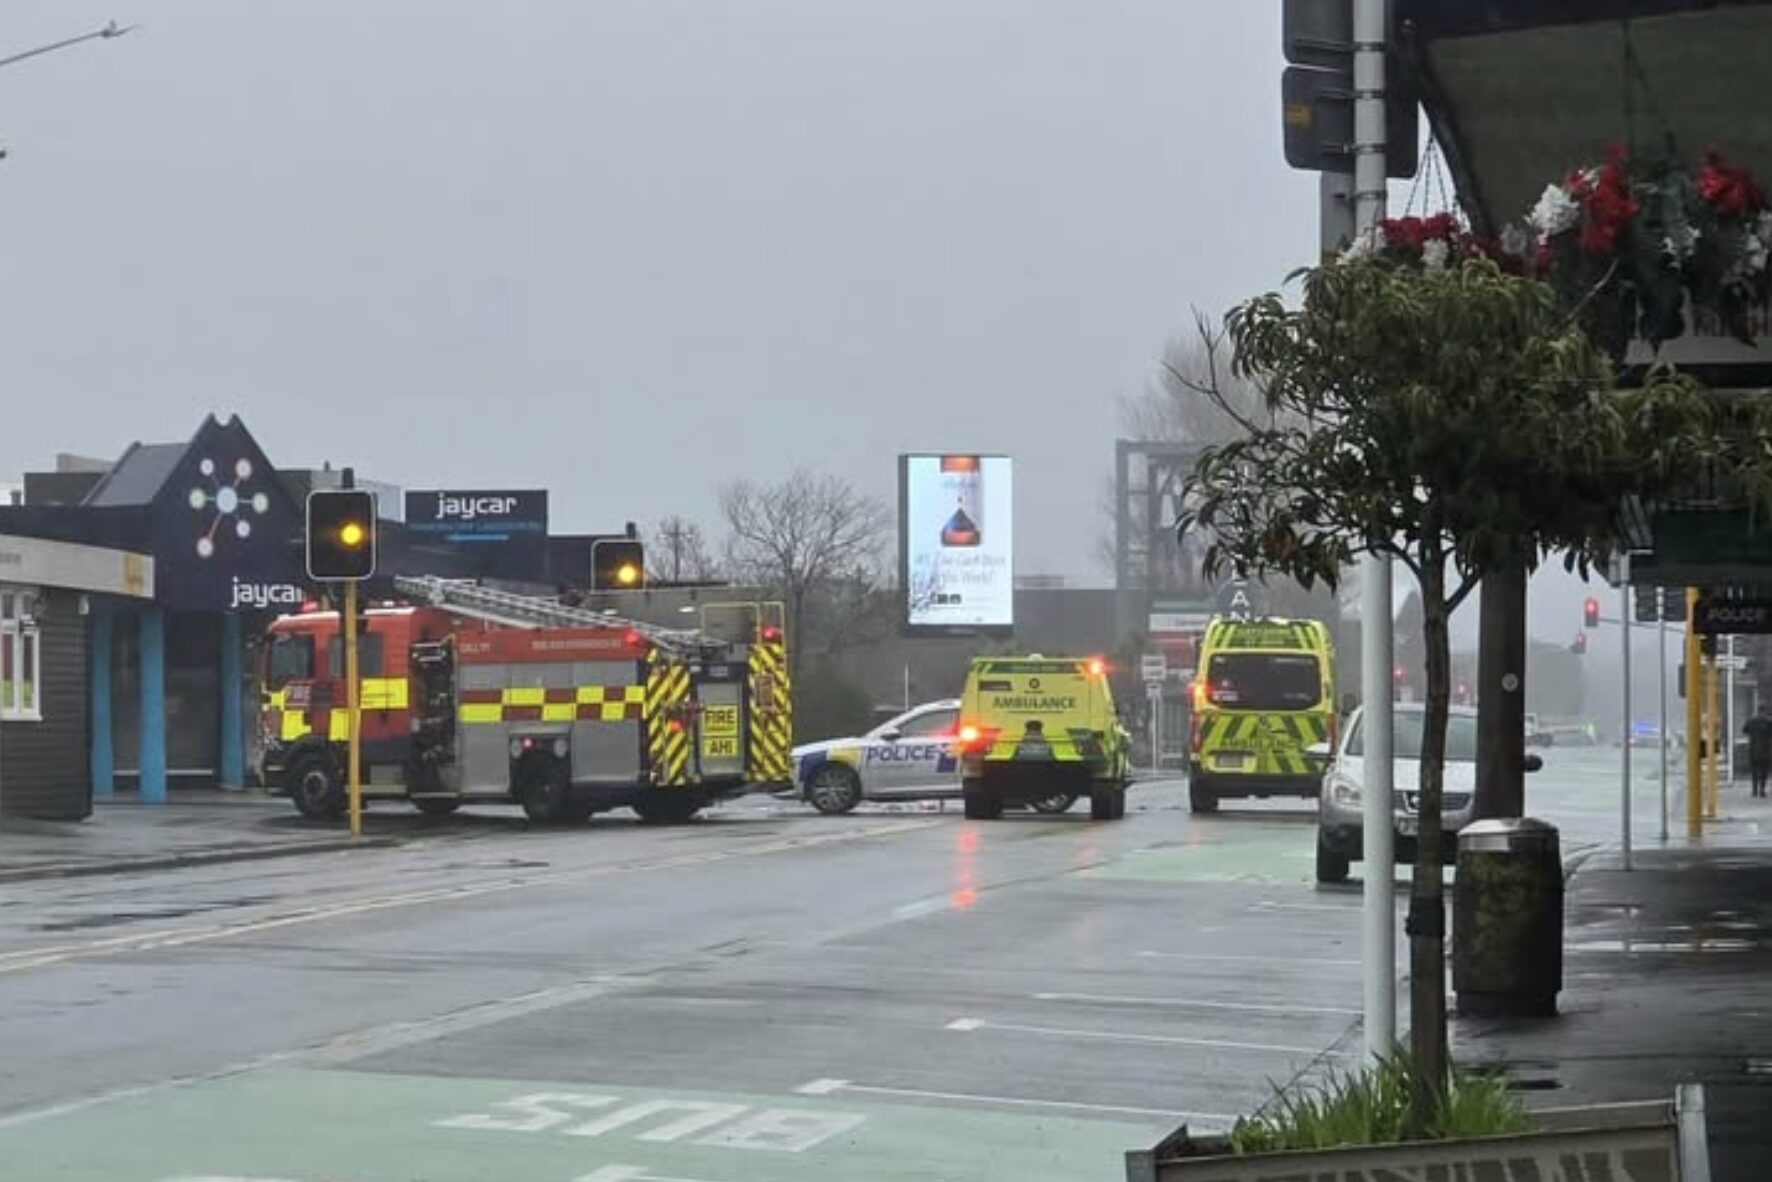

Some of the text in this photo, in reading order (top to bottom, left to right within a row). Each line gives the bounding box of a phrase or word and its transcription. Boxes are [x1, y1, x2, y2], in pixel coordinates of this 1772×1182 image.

[434, 491, 518, 519] jaycar
[993, 696, 1076, 709] AMBULANCE
[705, 710, 735, 724] FIRE
[867, 745, 937, 761] POLICE
[430, 1091, 867, 1153] BUS
